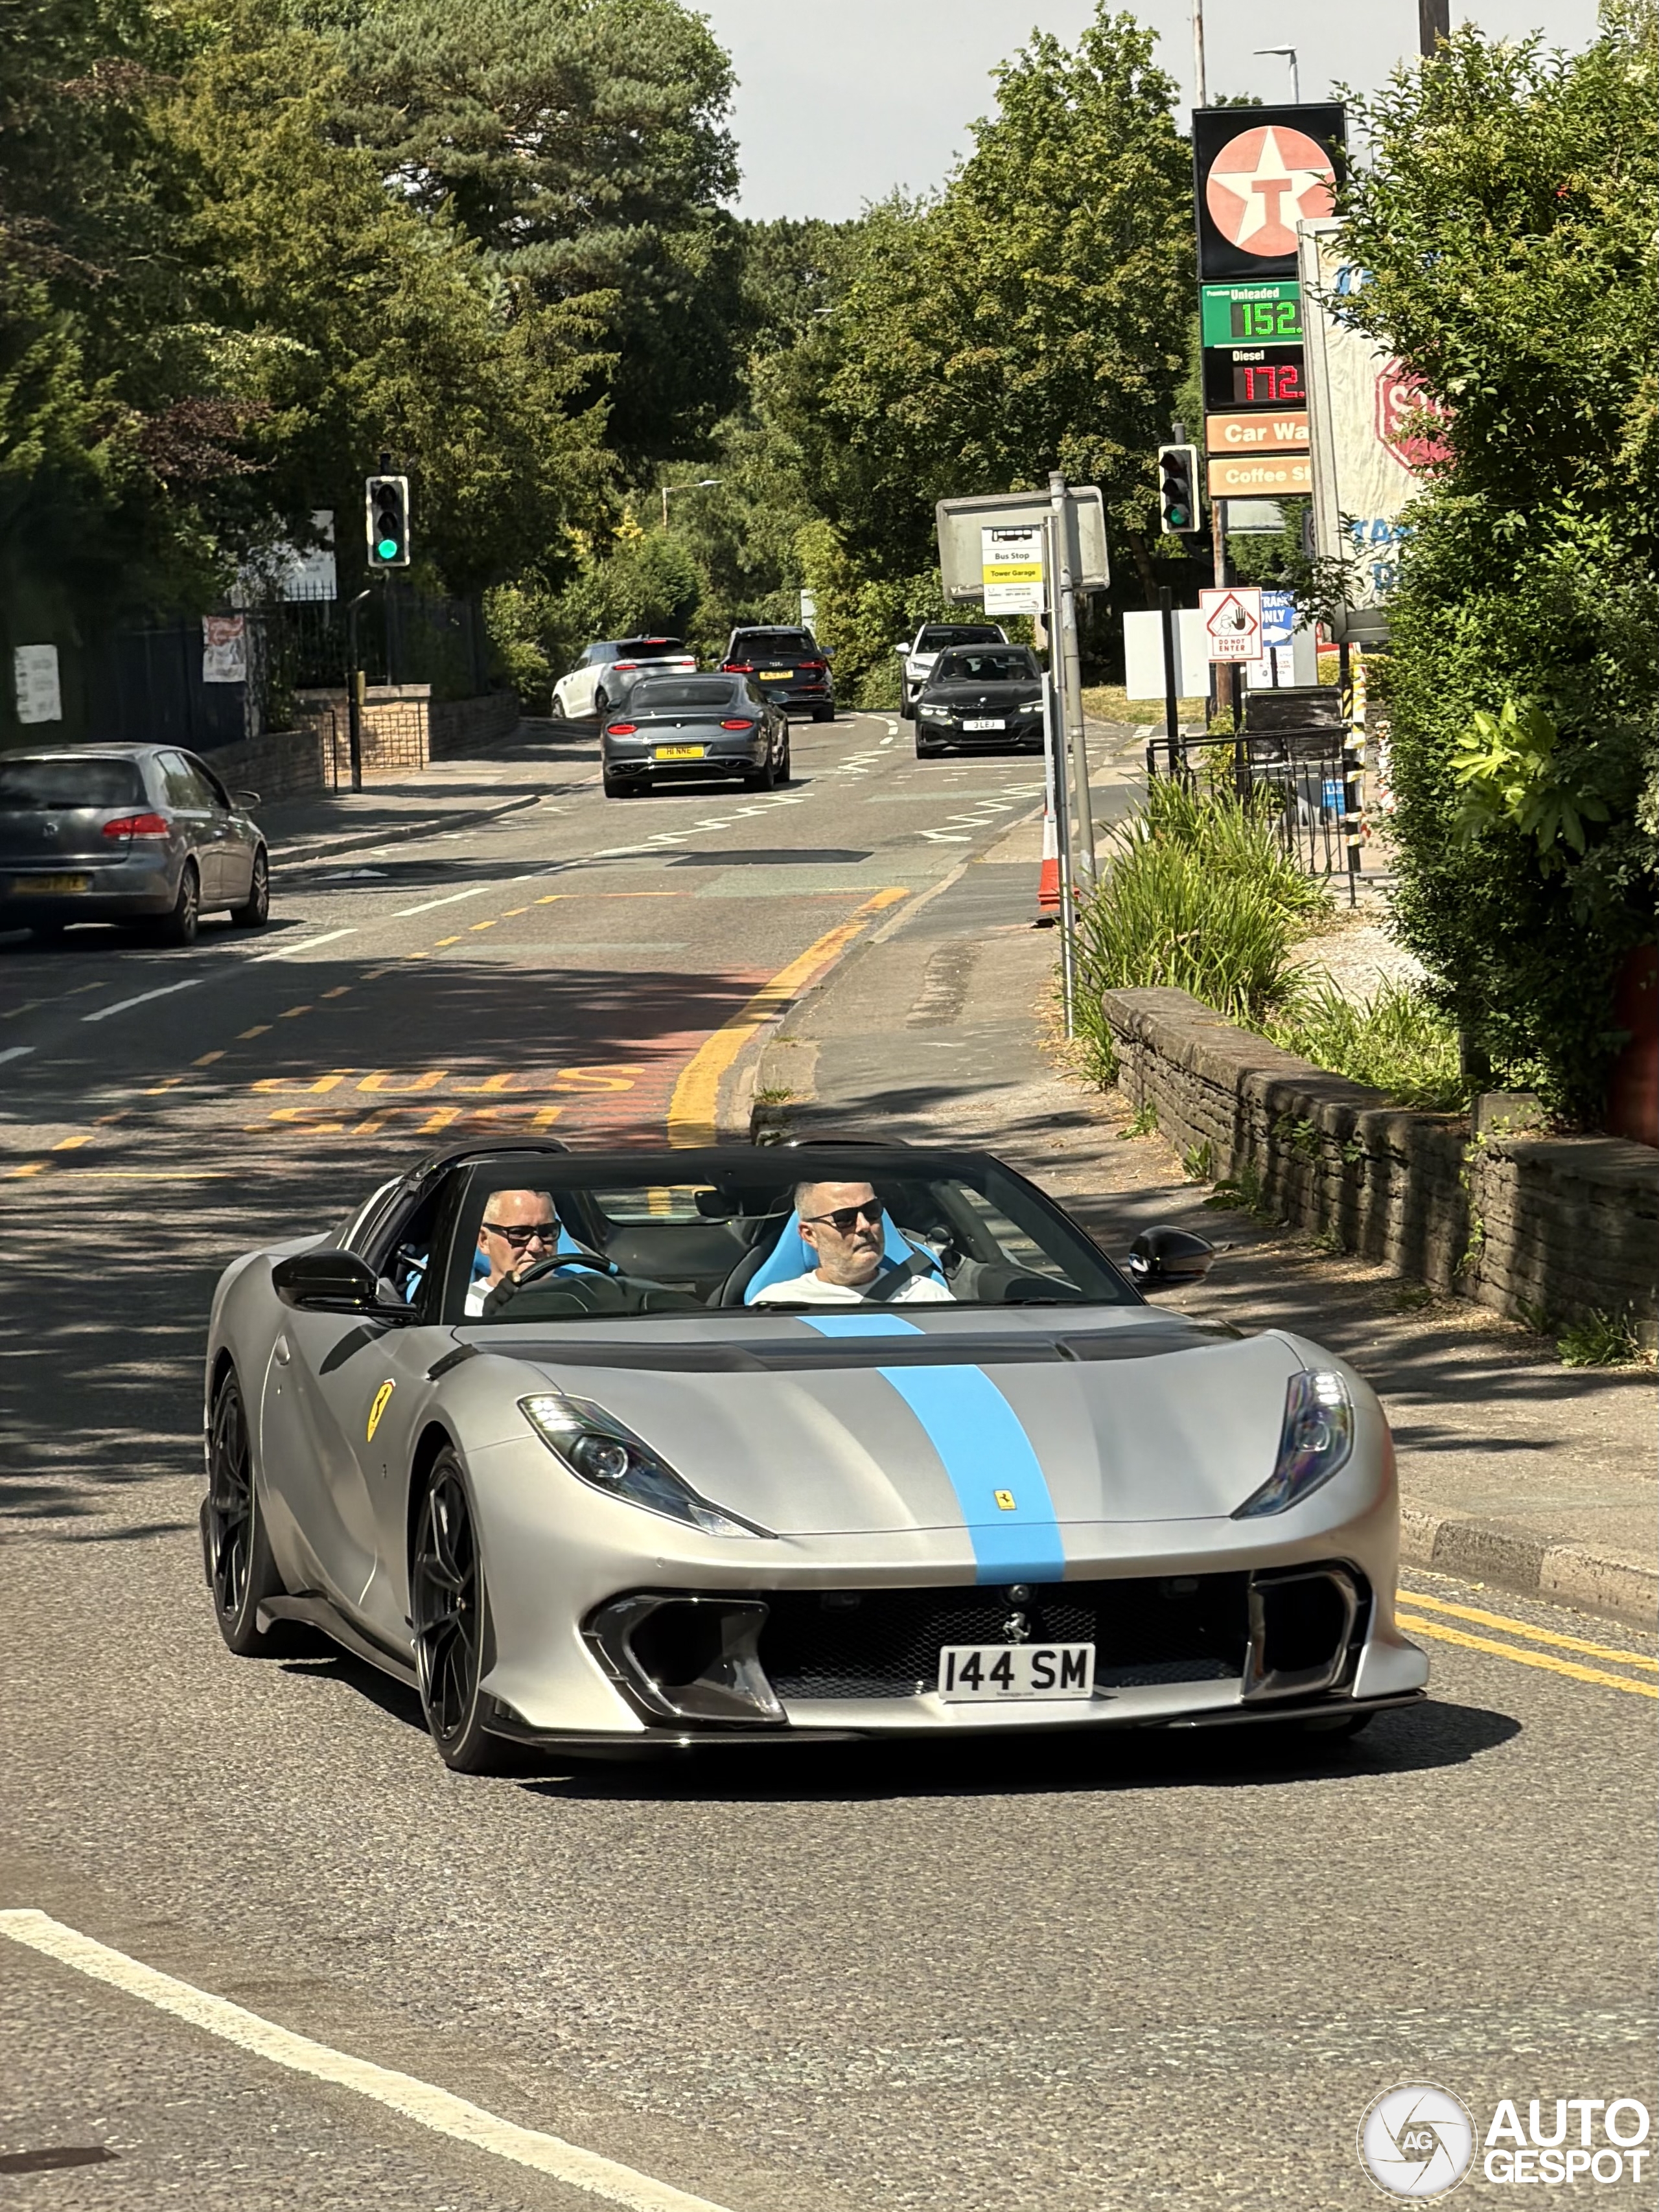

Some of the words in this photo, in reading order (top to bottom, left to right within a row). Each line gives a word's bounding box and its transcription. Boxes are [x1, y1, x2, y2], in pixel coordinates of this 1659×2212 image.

[1231, 287, 1280, 300] Unleaded
[1233, 350, 1264, 361] Diesel
[1225, 424, 1267, 443] Car
[1225, 467, 1287, 484] Coffee
[1030, 1649, 1088, 1689] SM
